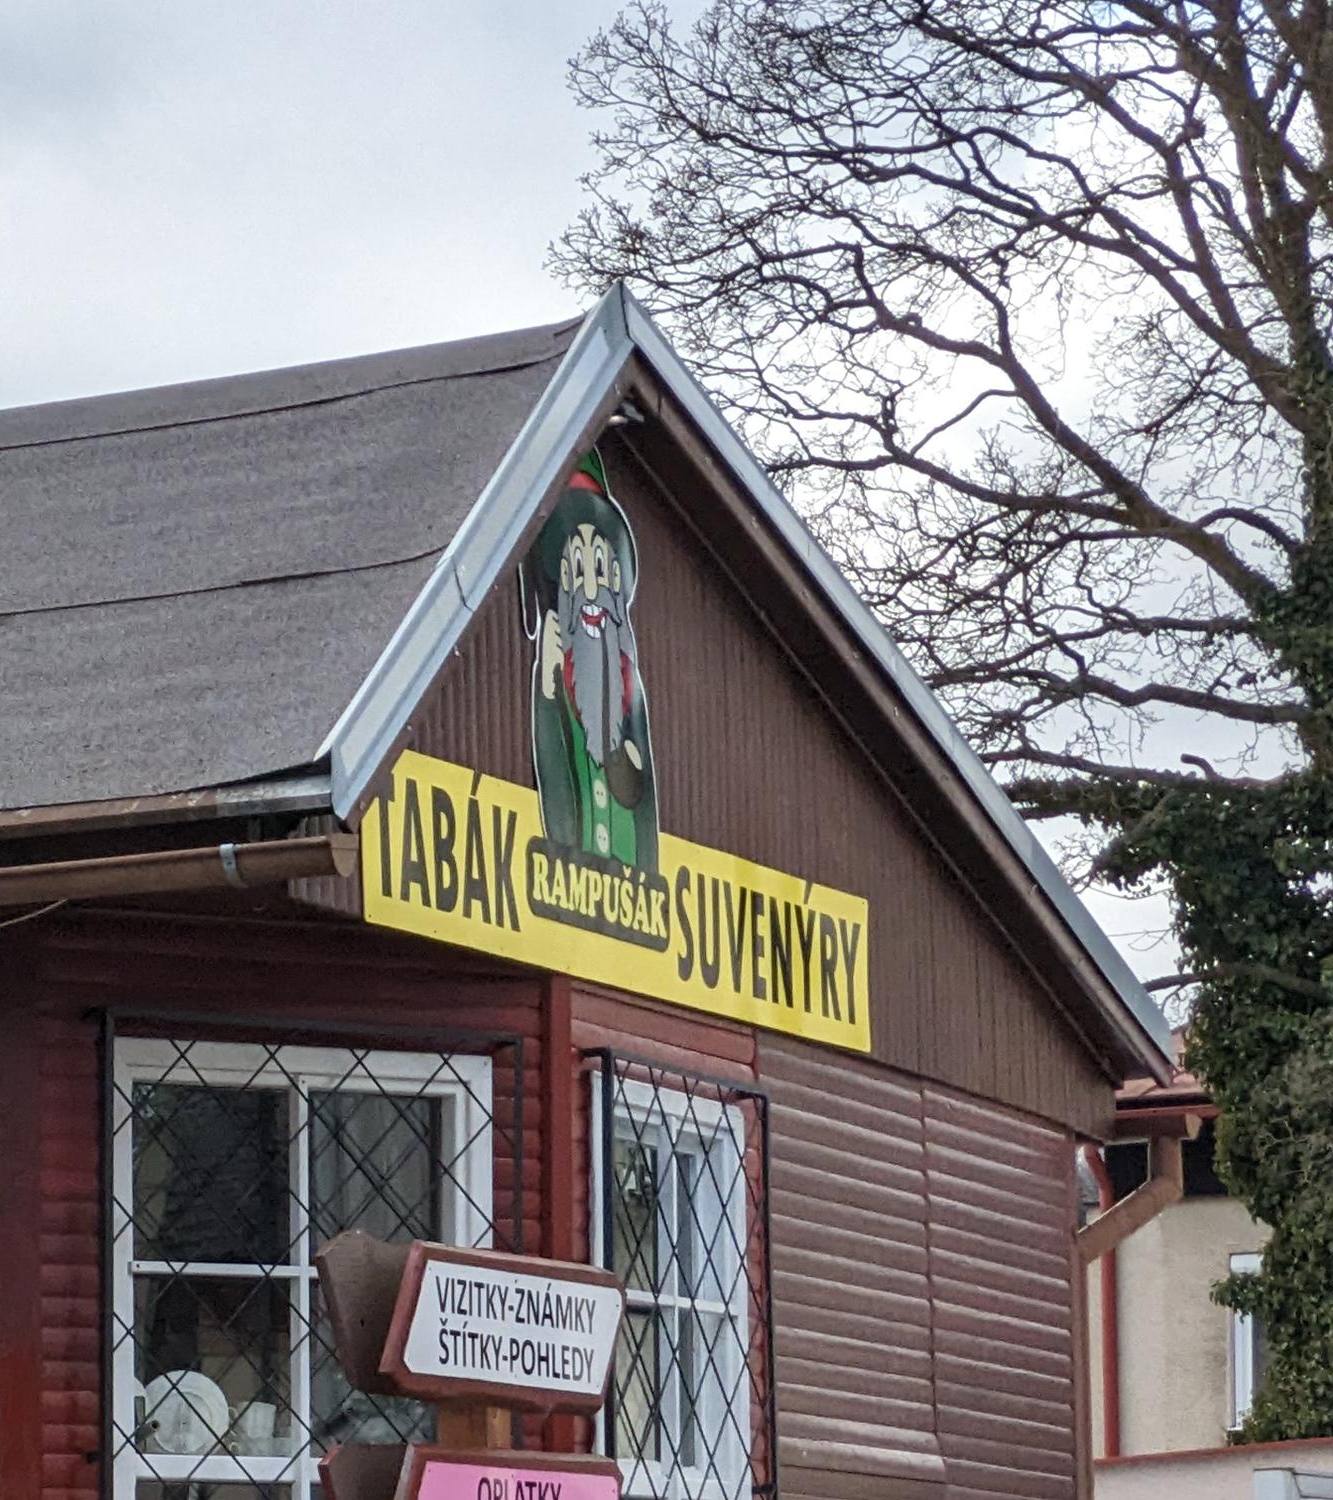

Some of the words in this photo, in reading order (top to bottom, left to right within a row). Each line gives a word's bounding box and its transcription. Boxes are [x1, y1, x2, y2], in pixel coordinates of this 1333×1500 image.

[376, 768, 521, 932] TABÁK
[532, 851, 669, 939] RAMPUŠÁK
[675, 865, 861, 1025] SUVENÝRY
[436, 1276, 596, 1335] VIZITKY-ZNÁMKY
[439, 1317, 595, 1384] ŠTÍTKY-POHLEDY
